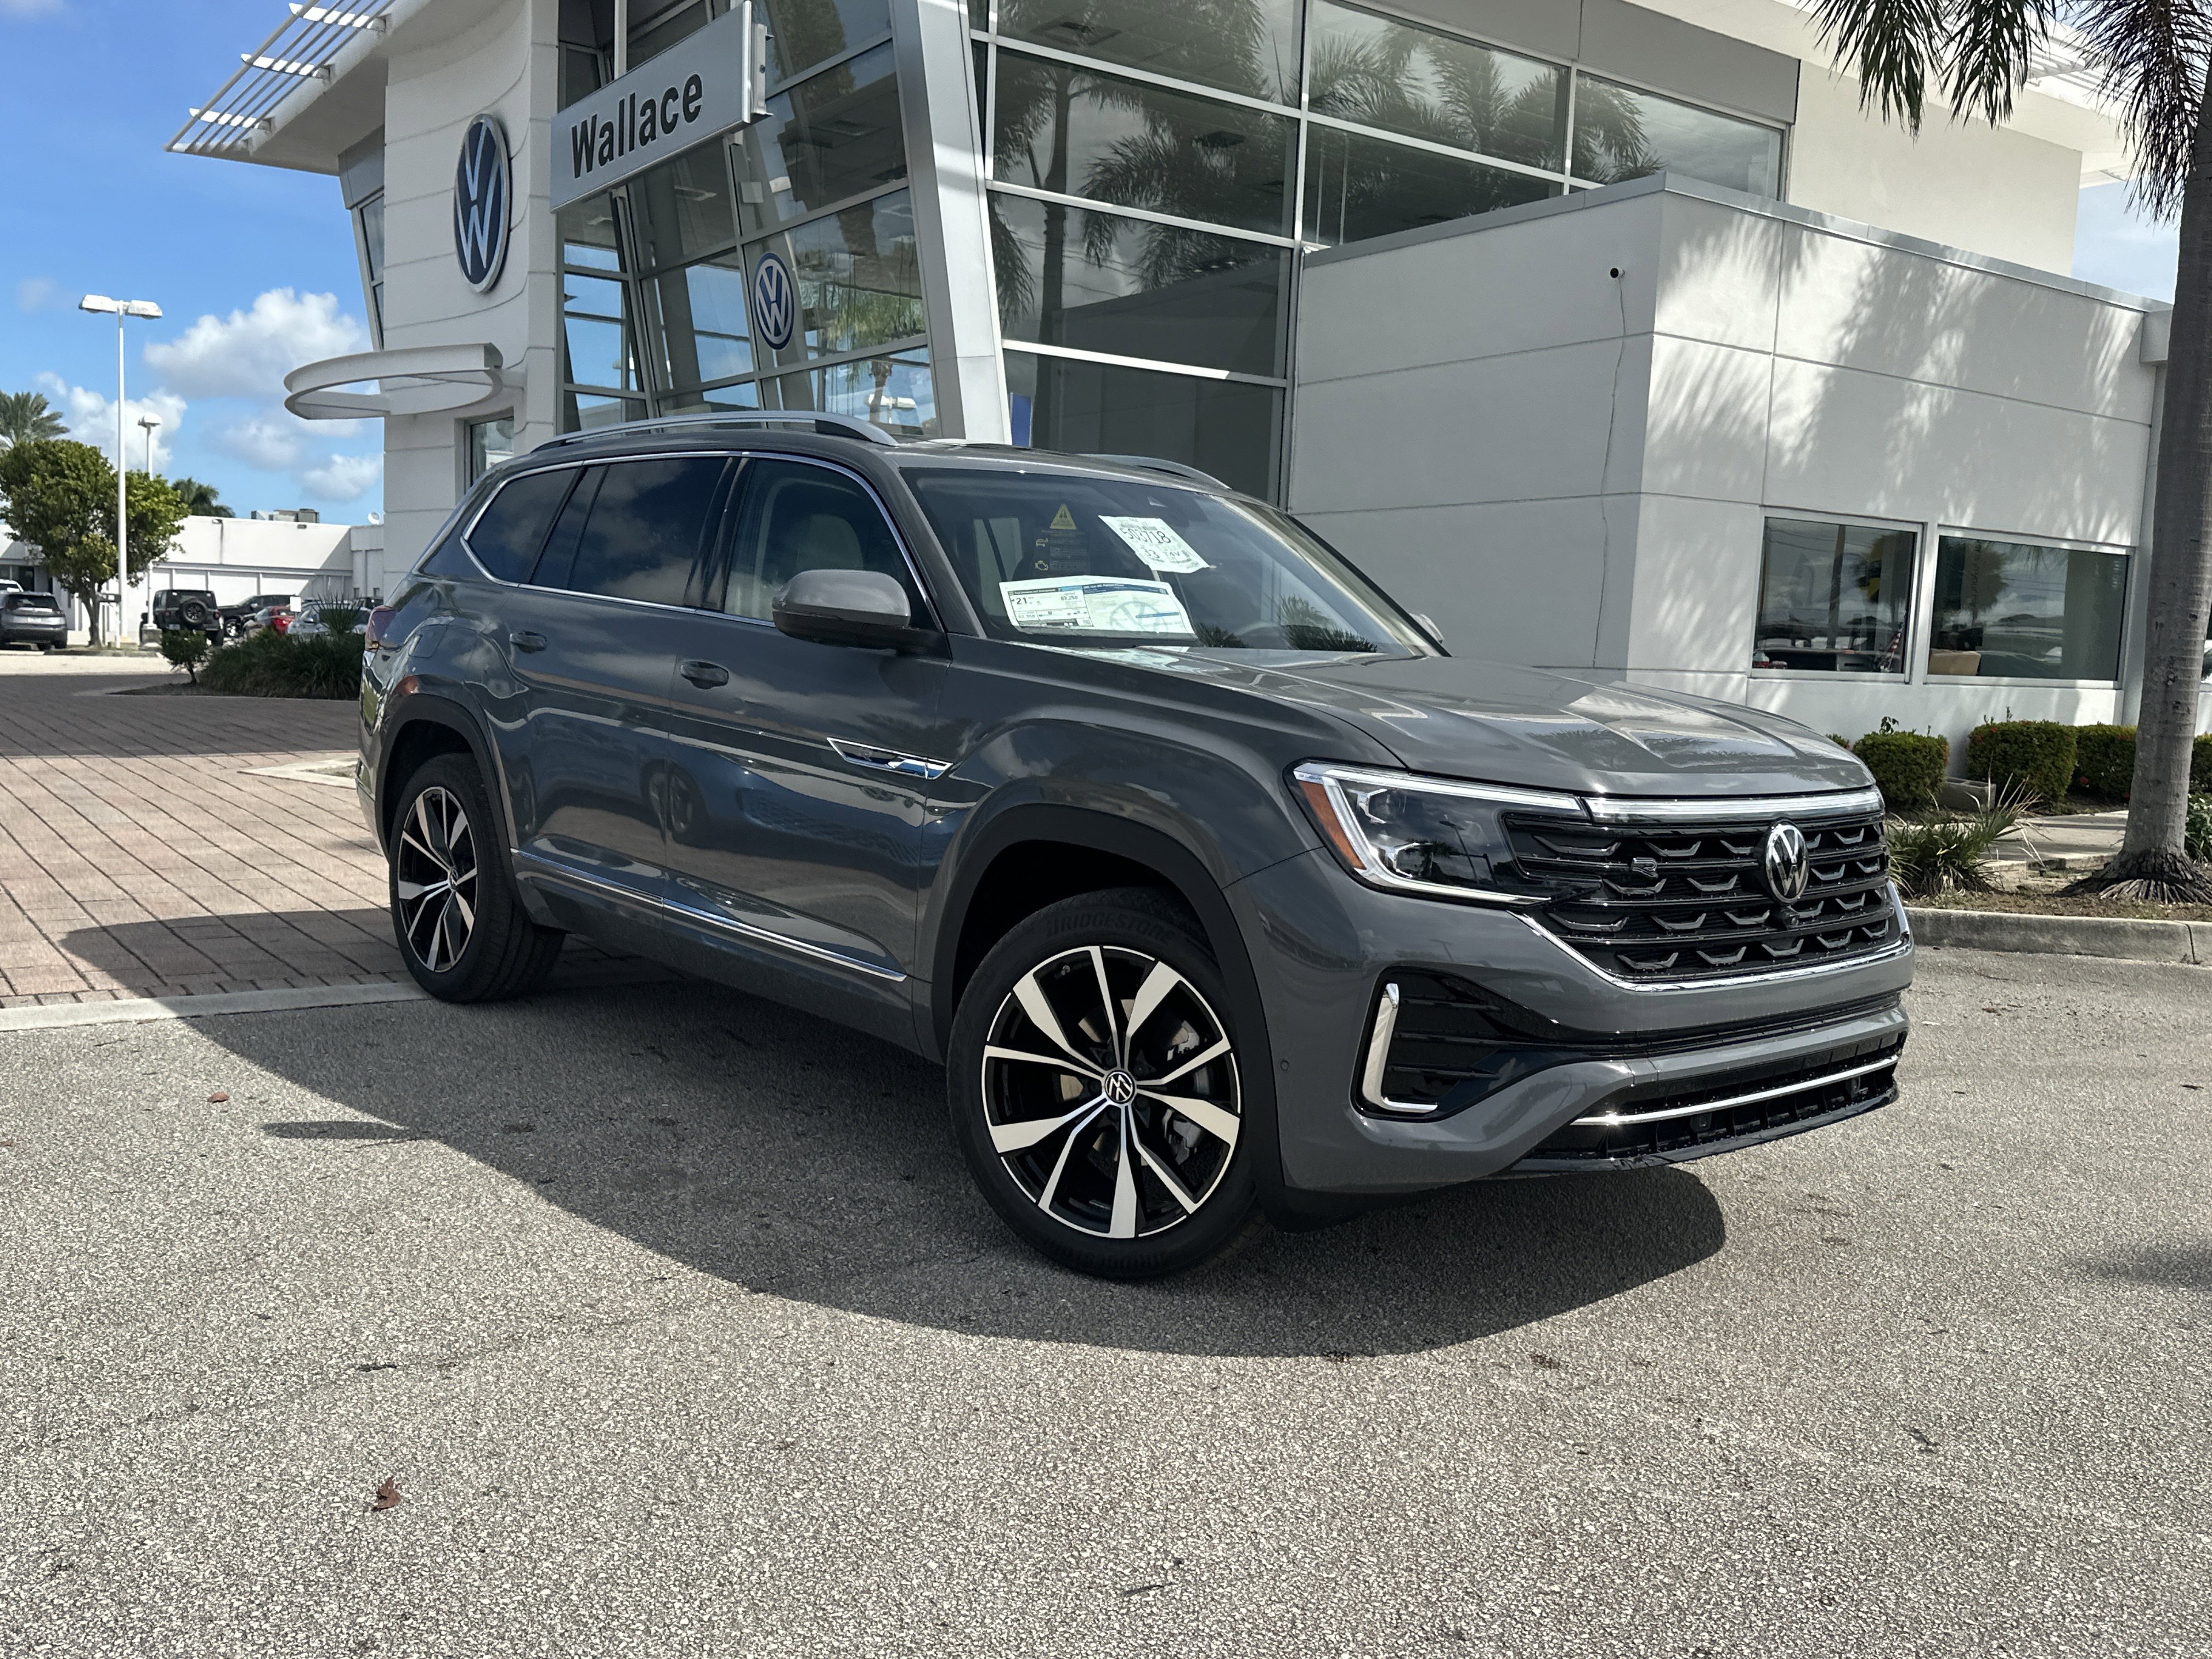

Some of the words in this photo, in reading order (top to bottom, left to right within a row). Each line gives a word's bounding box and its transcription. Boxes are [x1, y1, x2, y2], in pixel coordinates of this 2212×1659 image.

[571, 73, 703, 179] Wallace
[454, 114, 510, 291] VW
[754, 253, 794, 350] VW
[1119, 528, 1171, 544] 503718
[1766, 825, 1809, 904] VW
[1105, 1071, 1133, 1102] VW
